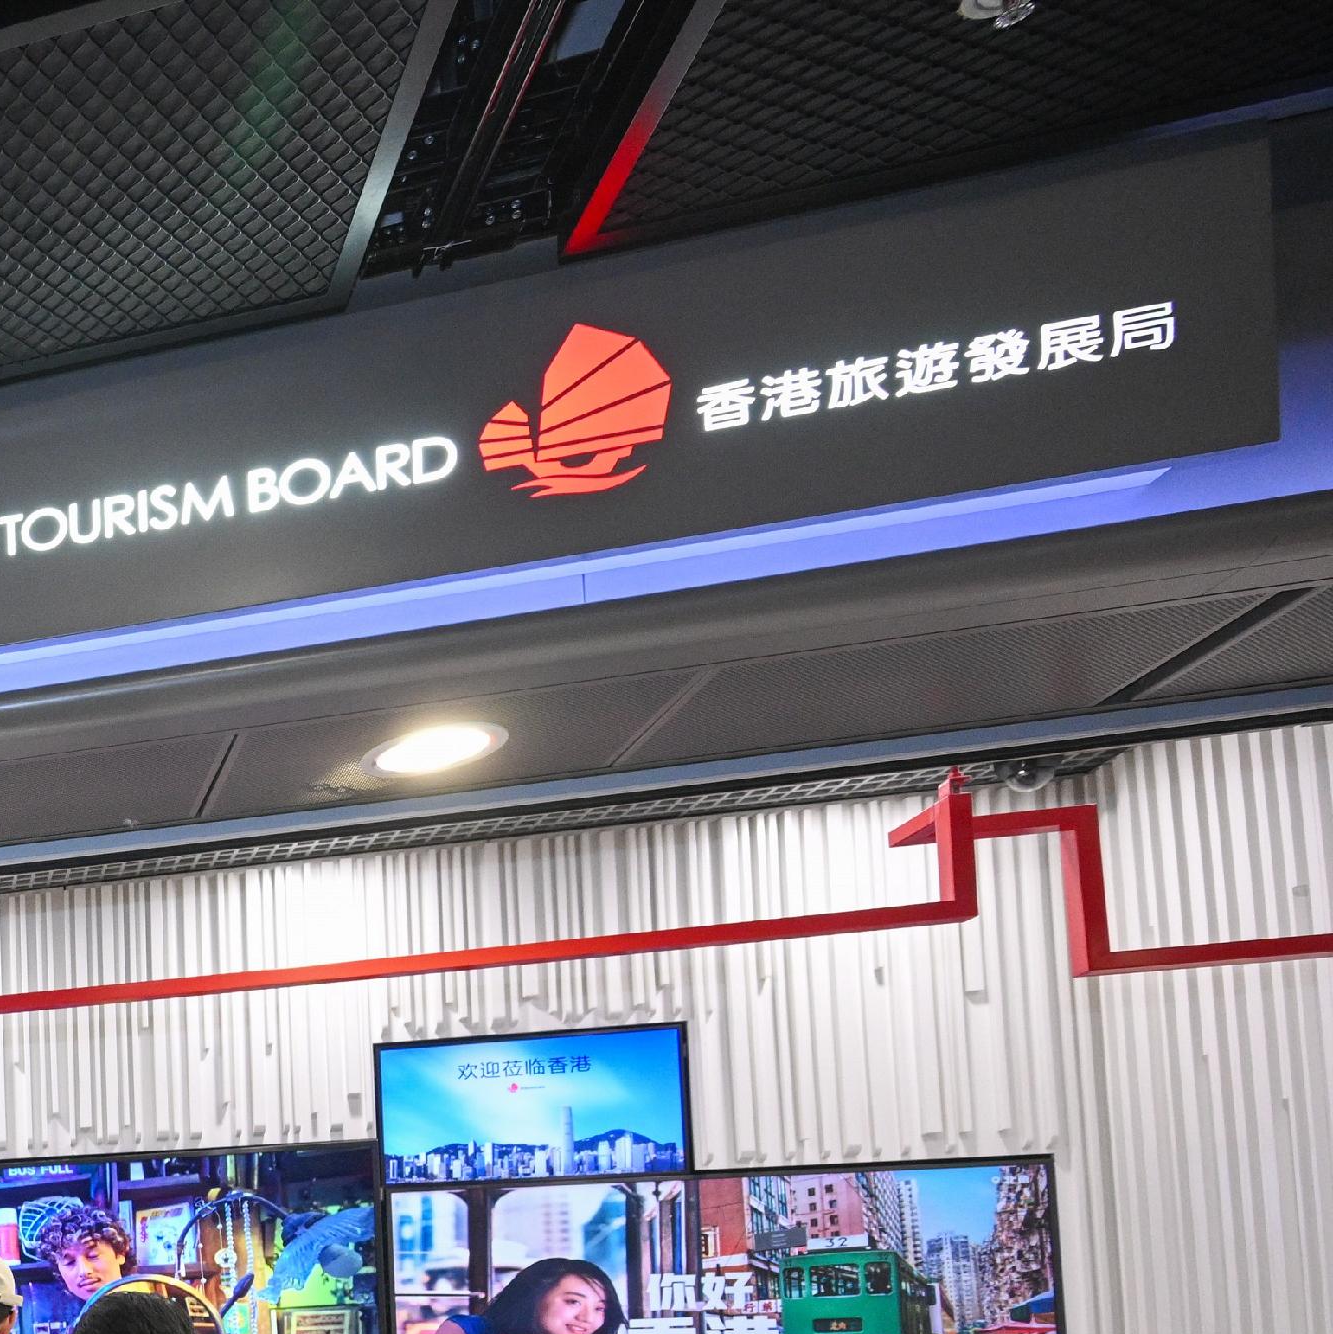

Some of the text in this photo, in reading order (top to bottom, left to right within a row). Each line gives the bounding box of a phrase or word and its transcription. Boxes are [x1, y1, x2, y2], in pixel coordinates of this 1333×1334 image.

[696, 301, 1176, 433] 香港旅遊發展局
[241, 434, 460, 517] BOARD
[457, 1055, 591, 1081] 欢迎莅临香港
[824, 1237, 848, 1248] 32
[646, 1271, 754, 1312] 你好
